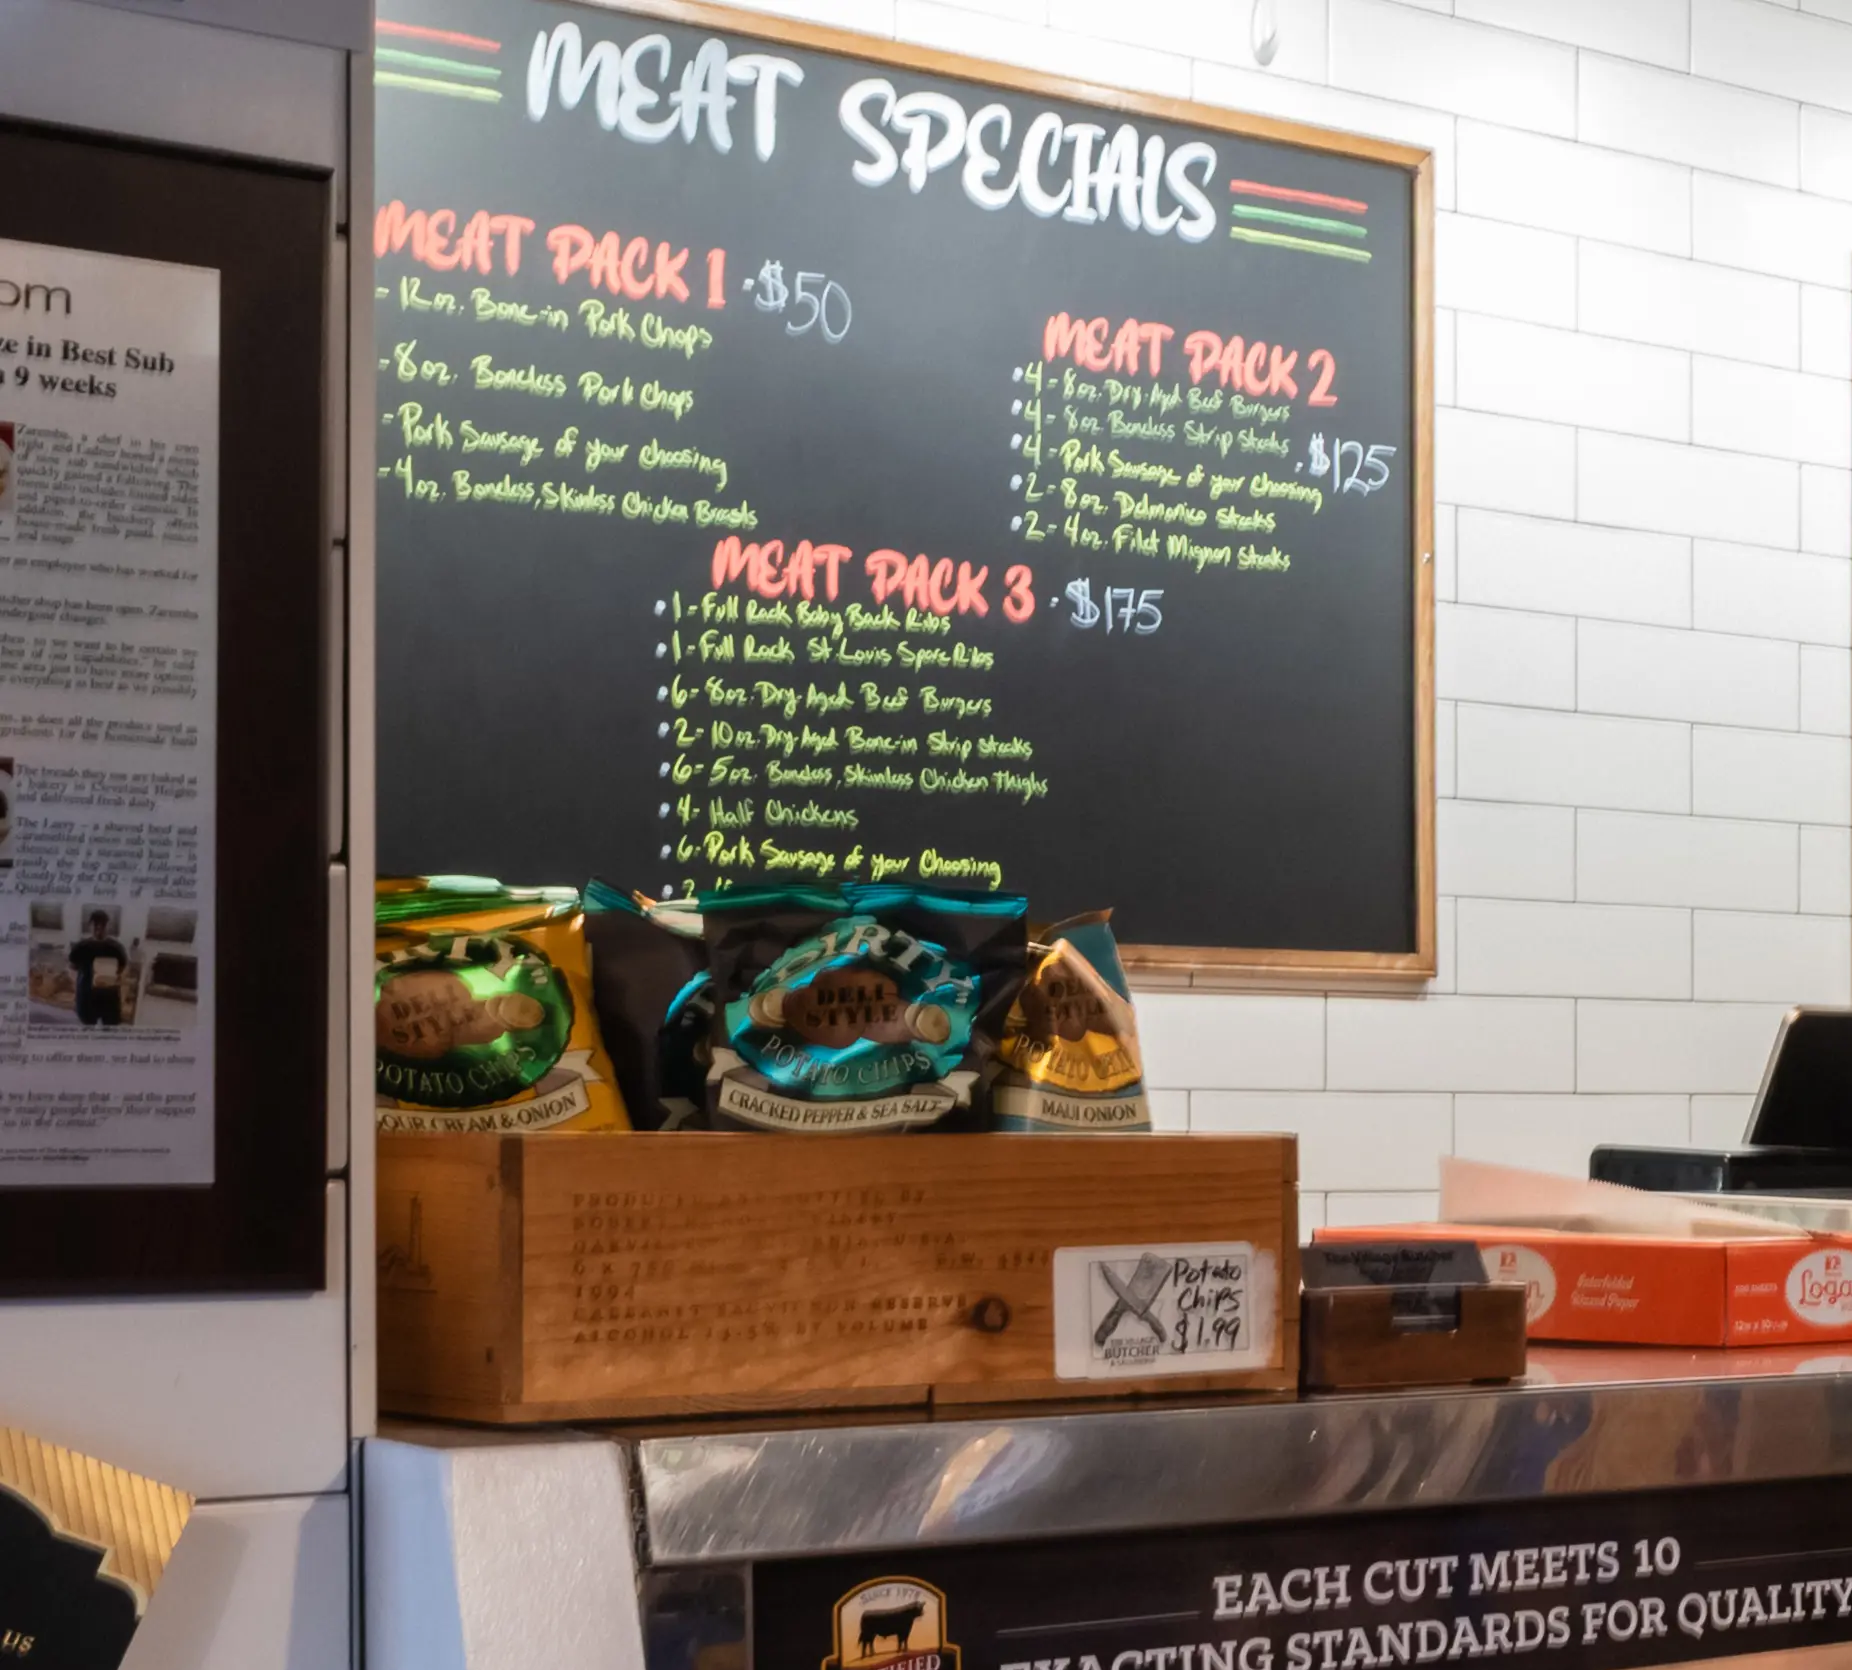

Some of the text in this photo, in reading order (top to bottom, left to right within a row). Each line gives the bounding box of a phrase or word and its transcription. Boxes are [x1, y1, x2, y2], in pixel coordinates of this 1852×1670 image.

[526, 21, 1219, 242] MEAT SPECIALS
[374, 200, 535, 276] MEAT
[547, 224, 690, 302] PACK
[706, 248, 726, 308] 1
[579, 299, 635, 342] Pork
[640, 312, 712, 359] Chops
[28, 337, 174, 375] in Best Sub
[1044, 312, 1174, 378] MEAT
[1185, 331, 1298, 400] PACK
[1307, 349, 1338, 407] 2
[15, 366, 117, 399] 9 weeks
[578, 372, 633, 408] Pork
[398, 402, 628, 472] Pork Sausage of your
[1167, 534, 1231, 573] Mignon
[711, 536, 852, 602] MEAT
[866, 549, 989, 617] PACK
[1003, 564, 1036, 624] 3
[701, 592, 741, 624] Full
[746, 602, 792, 628] Rack
[796, 600, 844, 638] Baby
[846, 603, 899, 631] Back
[700, 632, 736, 662] Full
[709, 799, 859, 830] Half Chickens
[703, 831, 755, 868] Pork
[760, 839, 835, 877] Sausage
[870, 855, 910, 881] your
[761, 1033, 930, 1086] POTATO CHIPS
[516, 1092, 578, 1125] ONION
[728, 1089, 940, 1124] CRACKED PEPPER & SEA SALT
[1041, 1099, 1137, 1122] MAUI ONION
[1174, 1258, 1241, 1286] Potato
[1104, 1345, 1160, 1359] BUTCHER
[1213, 1536, 1681, 1621] EACH CUT MEETS 10
[1581, 1598, 1668, 1644] FOR
